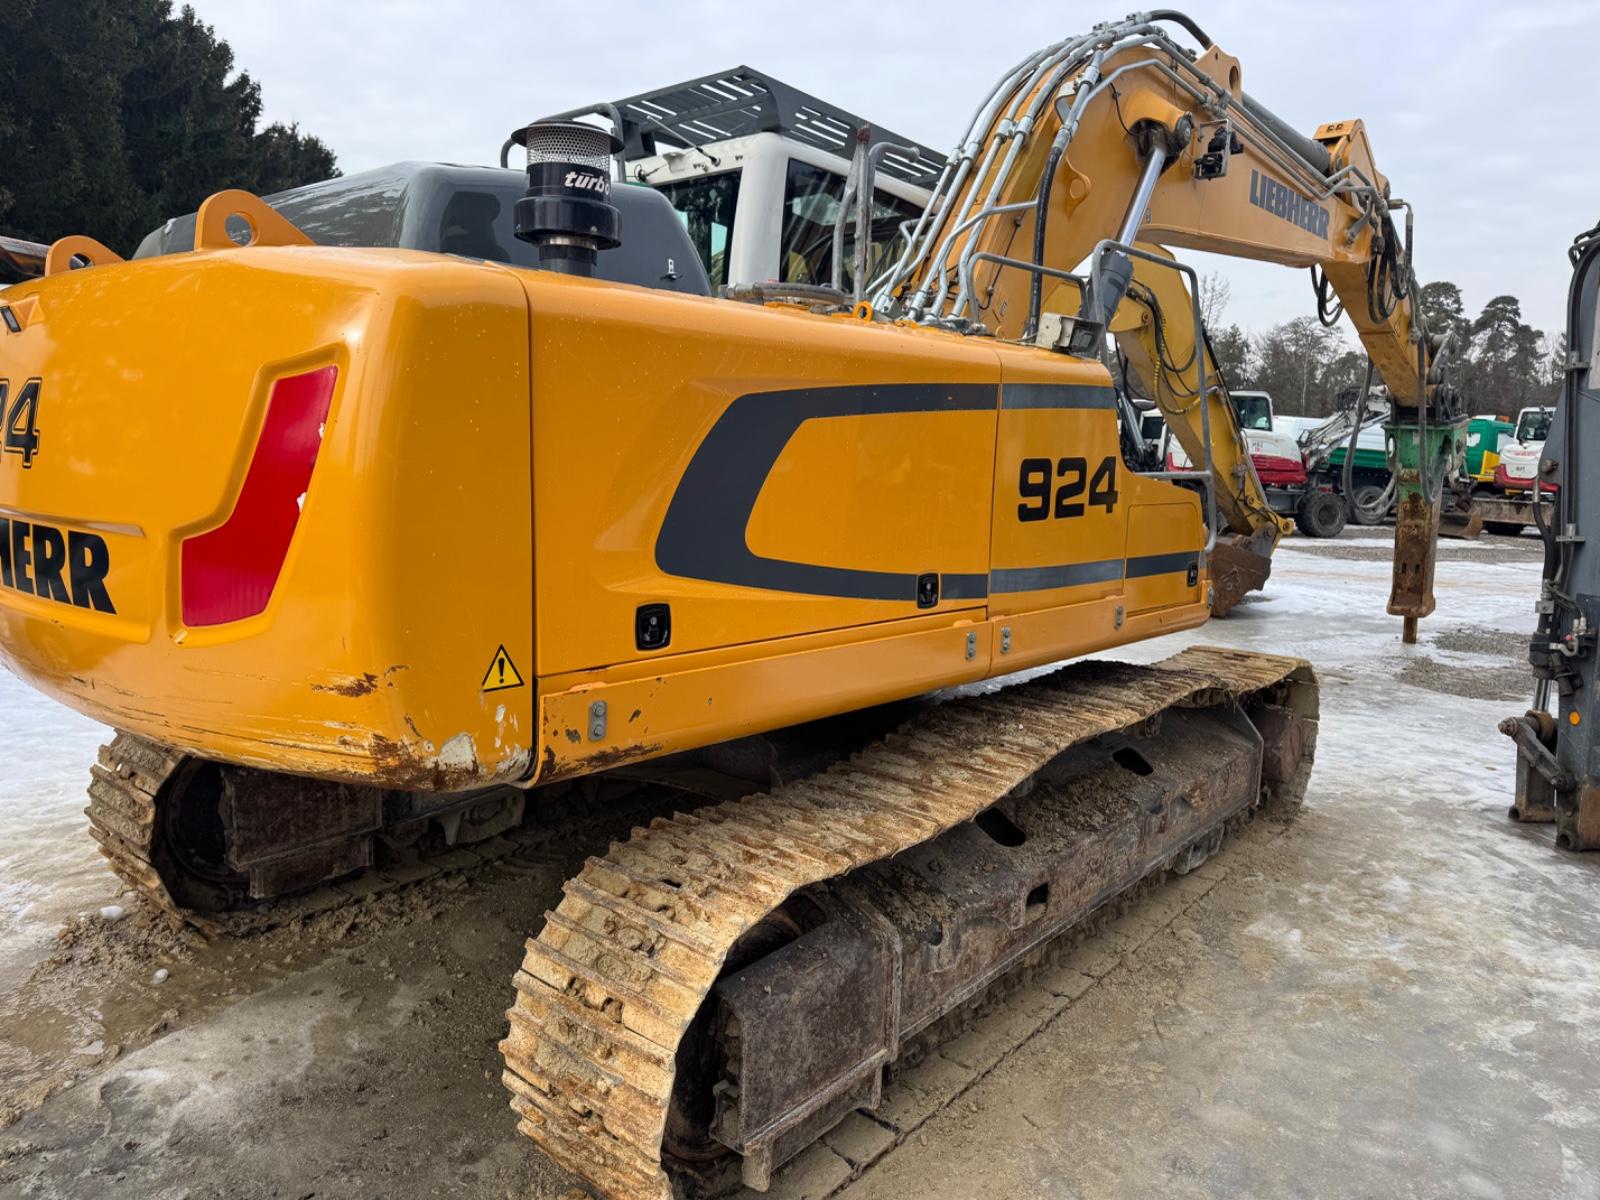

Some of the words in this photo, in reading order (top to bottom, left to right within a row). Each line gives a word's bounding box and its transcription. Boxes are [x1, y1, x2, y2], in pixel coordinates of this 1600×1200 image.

[564, 170, 610, 196] turbo
[1250, 169, 1330, 241] LIEBHERR
[1018, 456, 1118, 522] 924
